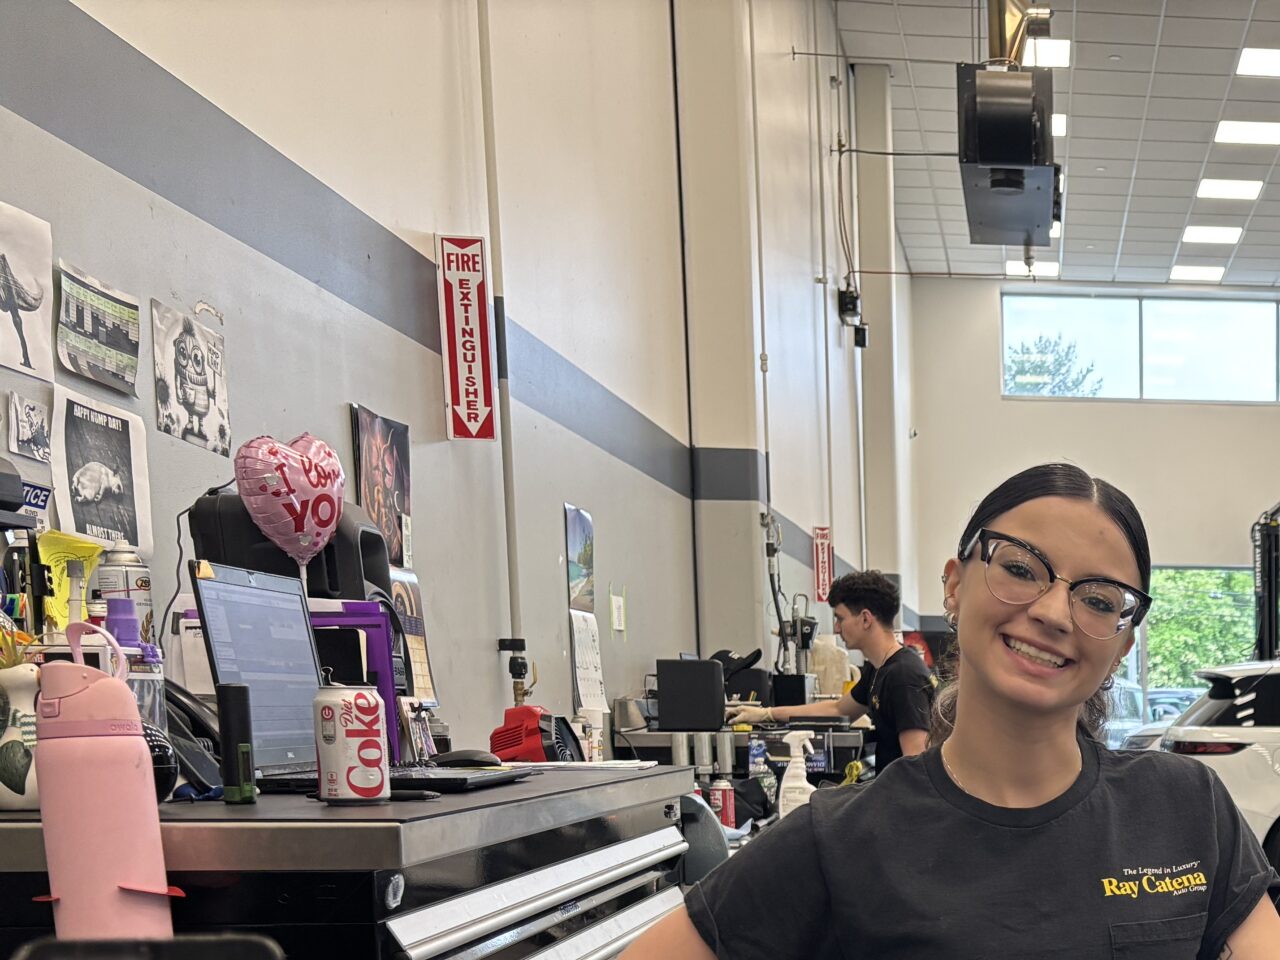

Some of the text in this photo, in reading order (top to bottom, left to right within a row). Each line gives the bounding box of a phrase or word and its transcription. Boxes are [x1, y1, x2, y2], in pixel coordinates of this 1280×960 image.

[446, 253, 480, 273] FIRE
[458, 279, 480, 423] EXTINGUISHER
[73, 403, 91, 421] HAPPY
[91, 410, 107, 427] HUMP
[274, 462, 296, 496] I
[23, 486, 49, 506] TICE
[86, 523, 108, 539] ALMOST
[339, 699, 354, 728] Diet
[345, 691, 385, 798] Coke
[1123, 868, 1137, 876] The
[1138, 866, 1163, 876] Legend
[1172, 860, 1198, 873] Luxury
[1101, 871, 1207, 898] Ray Catena
[1173, 884, 1207, 896] Auto Group
